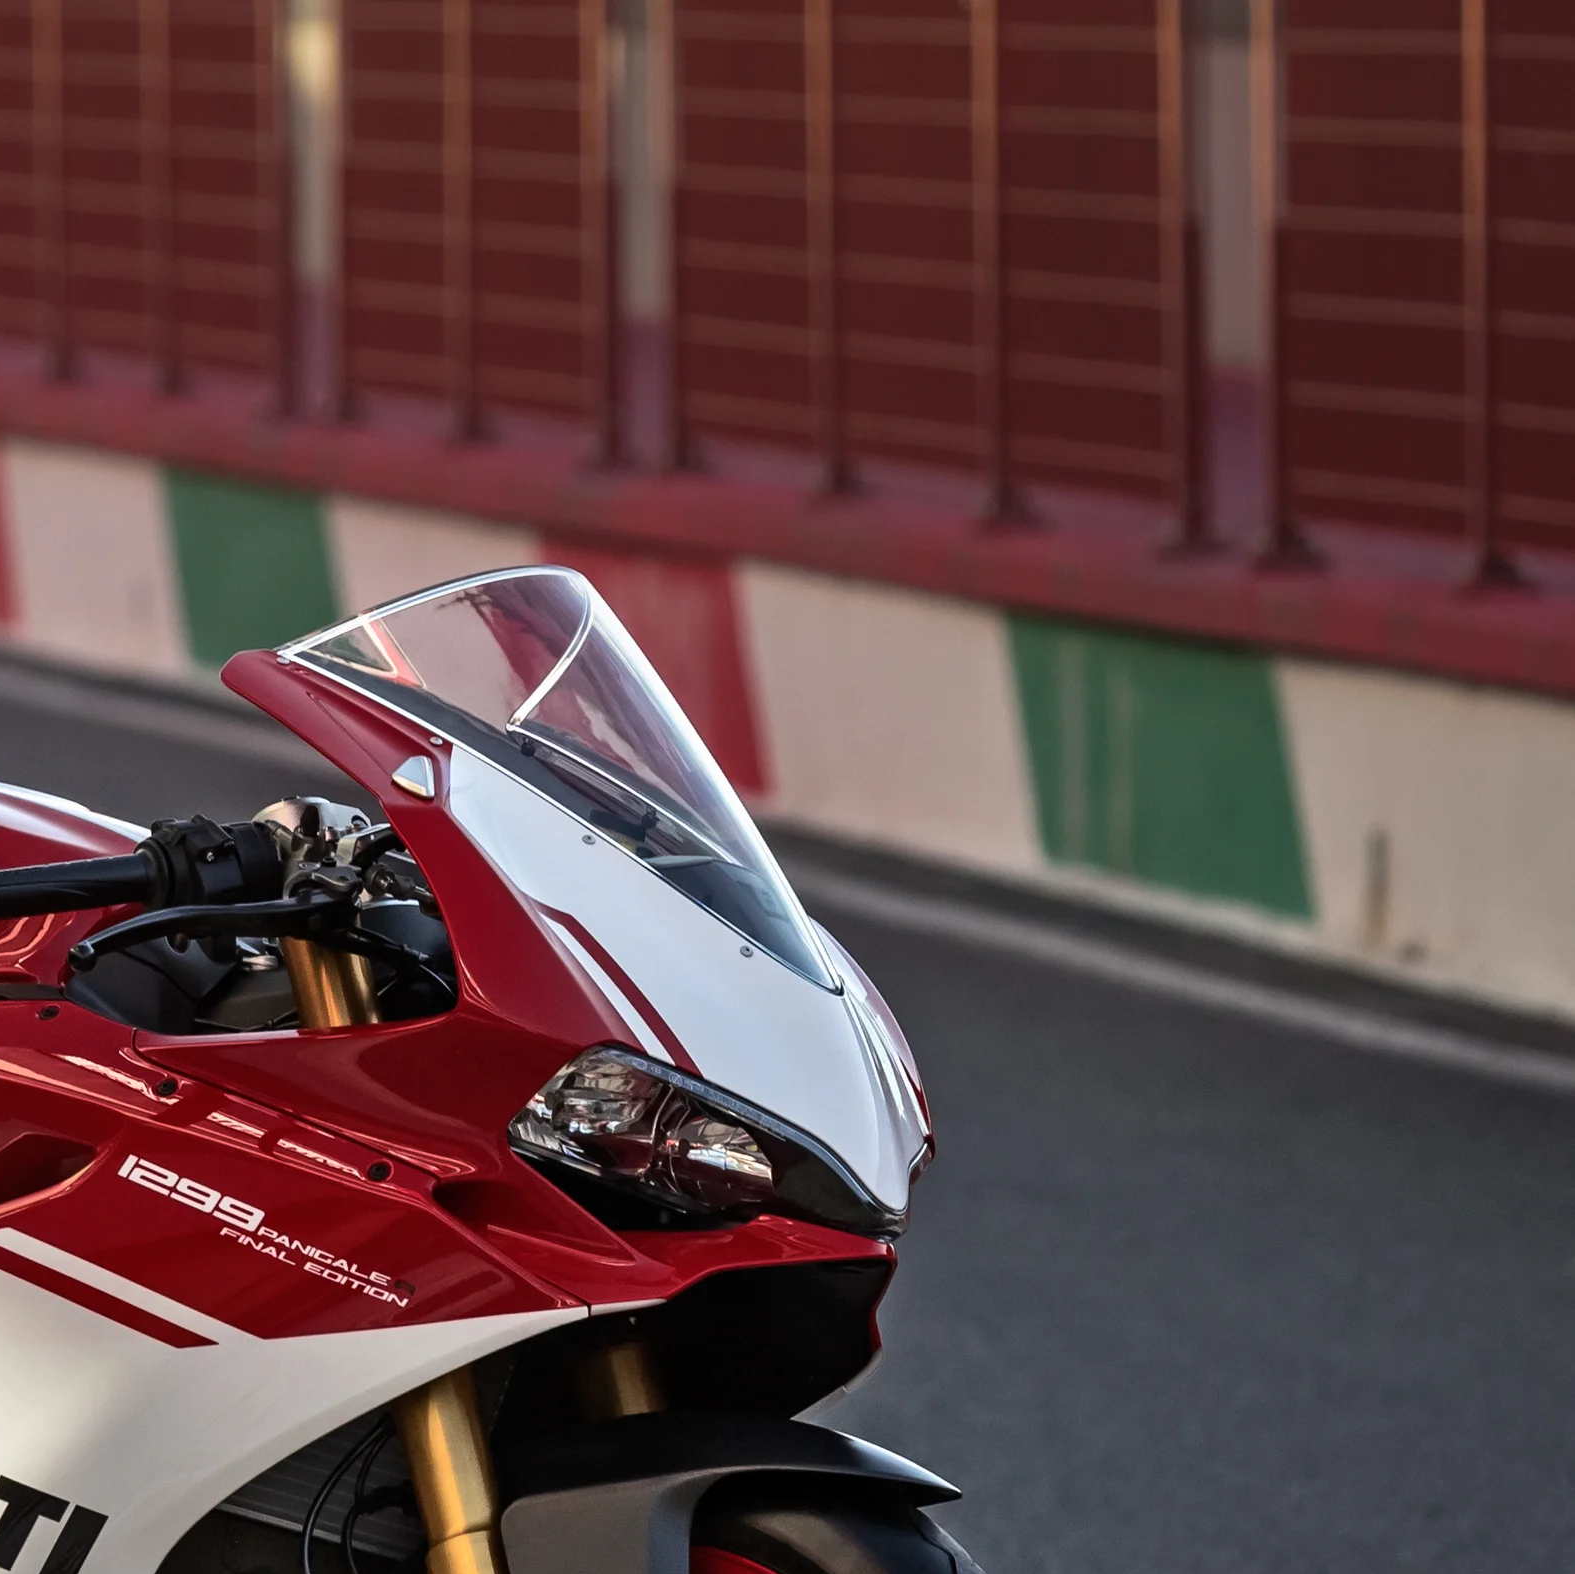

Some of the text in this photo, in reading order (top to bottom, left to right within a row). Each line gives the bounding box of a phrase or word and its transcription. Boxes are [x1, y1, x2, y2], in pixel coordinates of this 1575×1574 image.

[117, 1153, 391, 1287] 1299 PANIGALE
[220, 1226, 296, 1266] FINAL
[303, 1262, 409, 1308] EDITION
